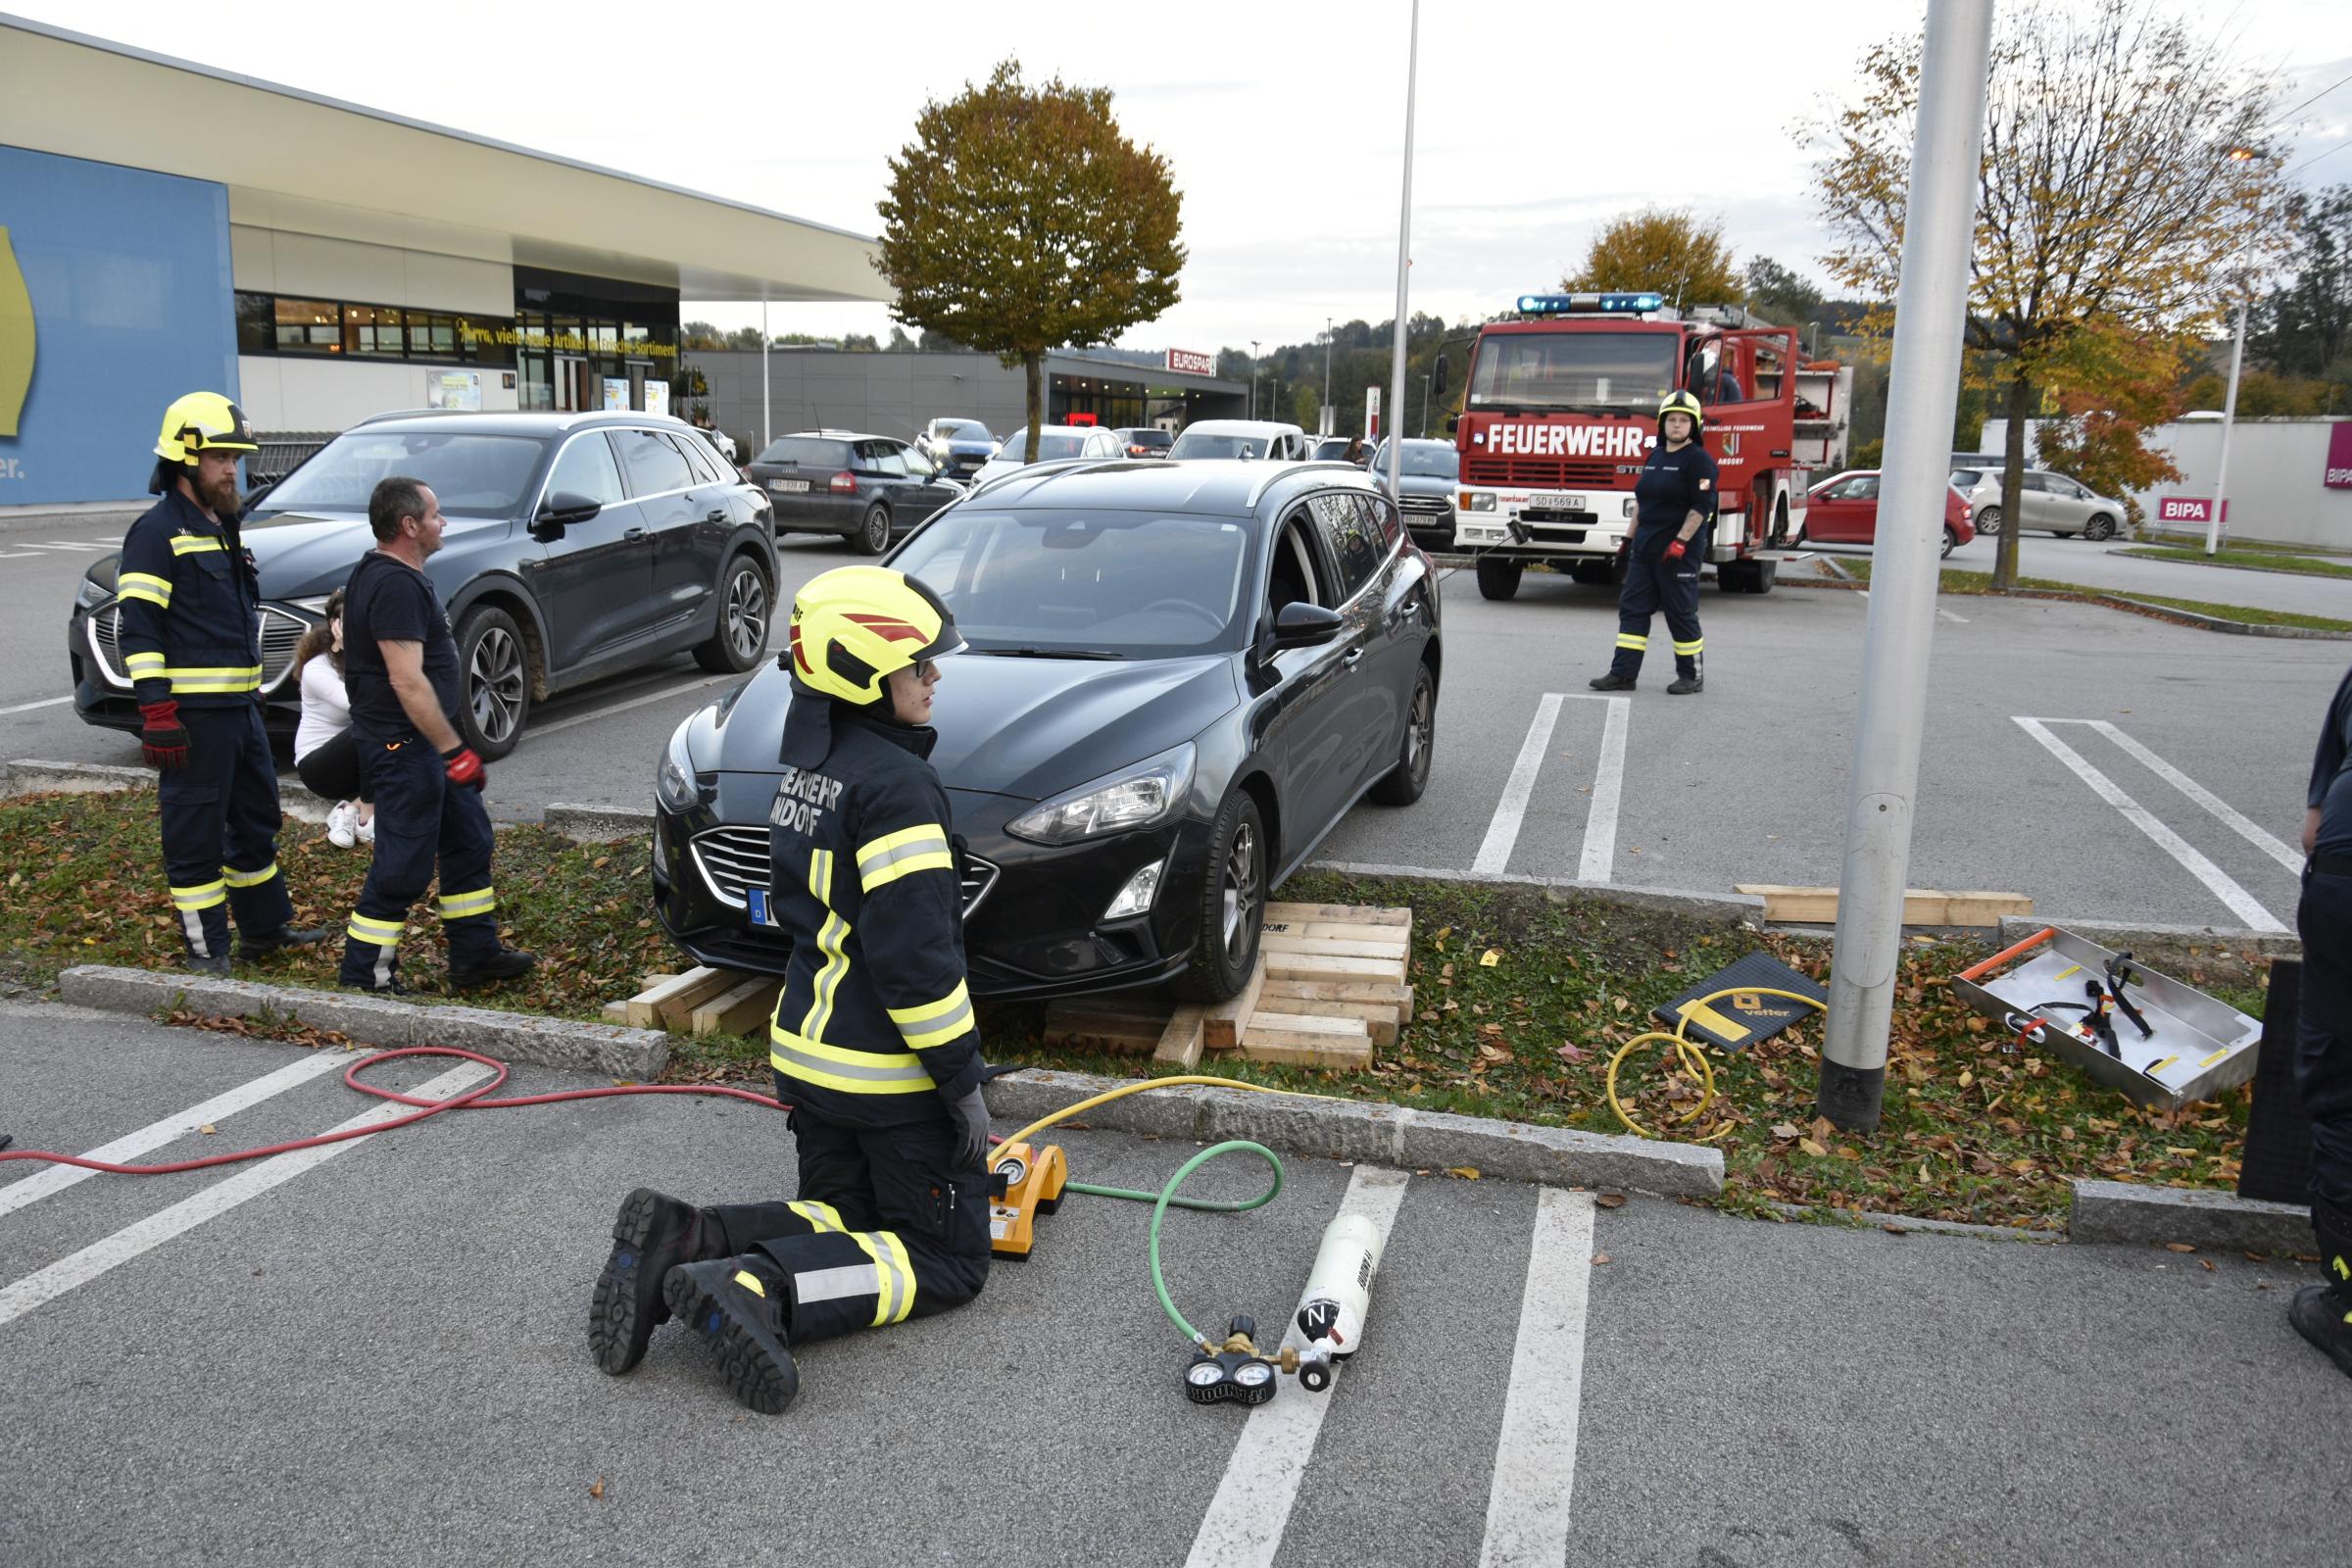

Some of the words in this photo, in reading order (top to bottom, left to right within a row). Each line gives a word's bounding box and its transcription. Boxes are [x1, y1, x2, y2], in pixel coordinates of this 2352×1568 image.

[554, 333, 586, 350] Artikel
[1173, 352, 1211, 372] EUROSPAR
[1488, 423, 1643, 457] FEUERWEHR
[1536, 497, 1547, 506] SD
[1553, 498, 1571, 507] 569
[2165, 502, 2205, 518] BIPA
[1307, 1305, 1325, 1327] N
